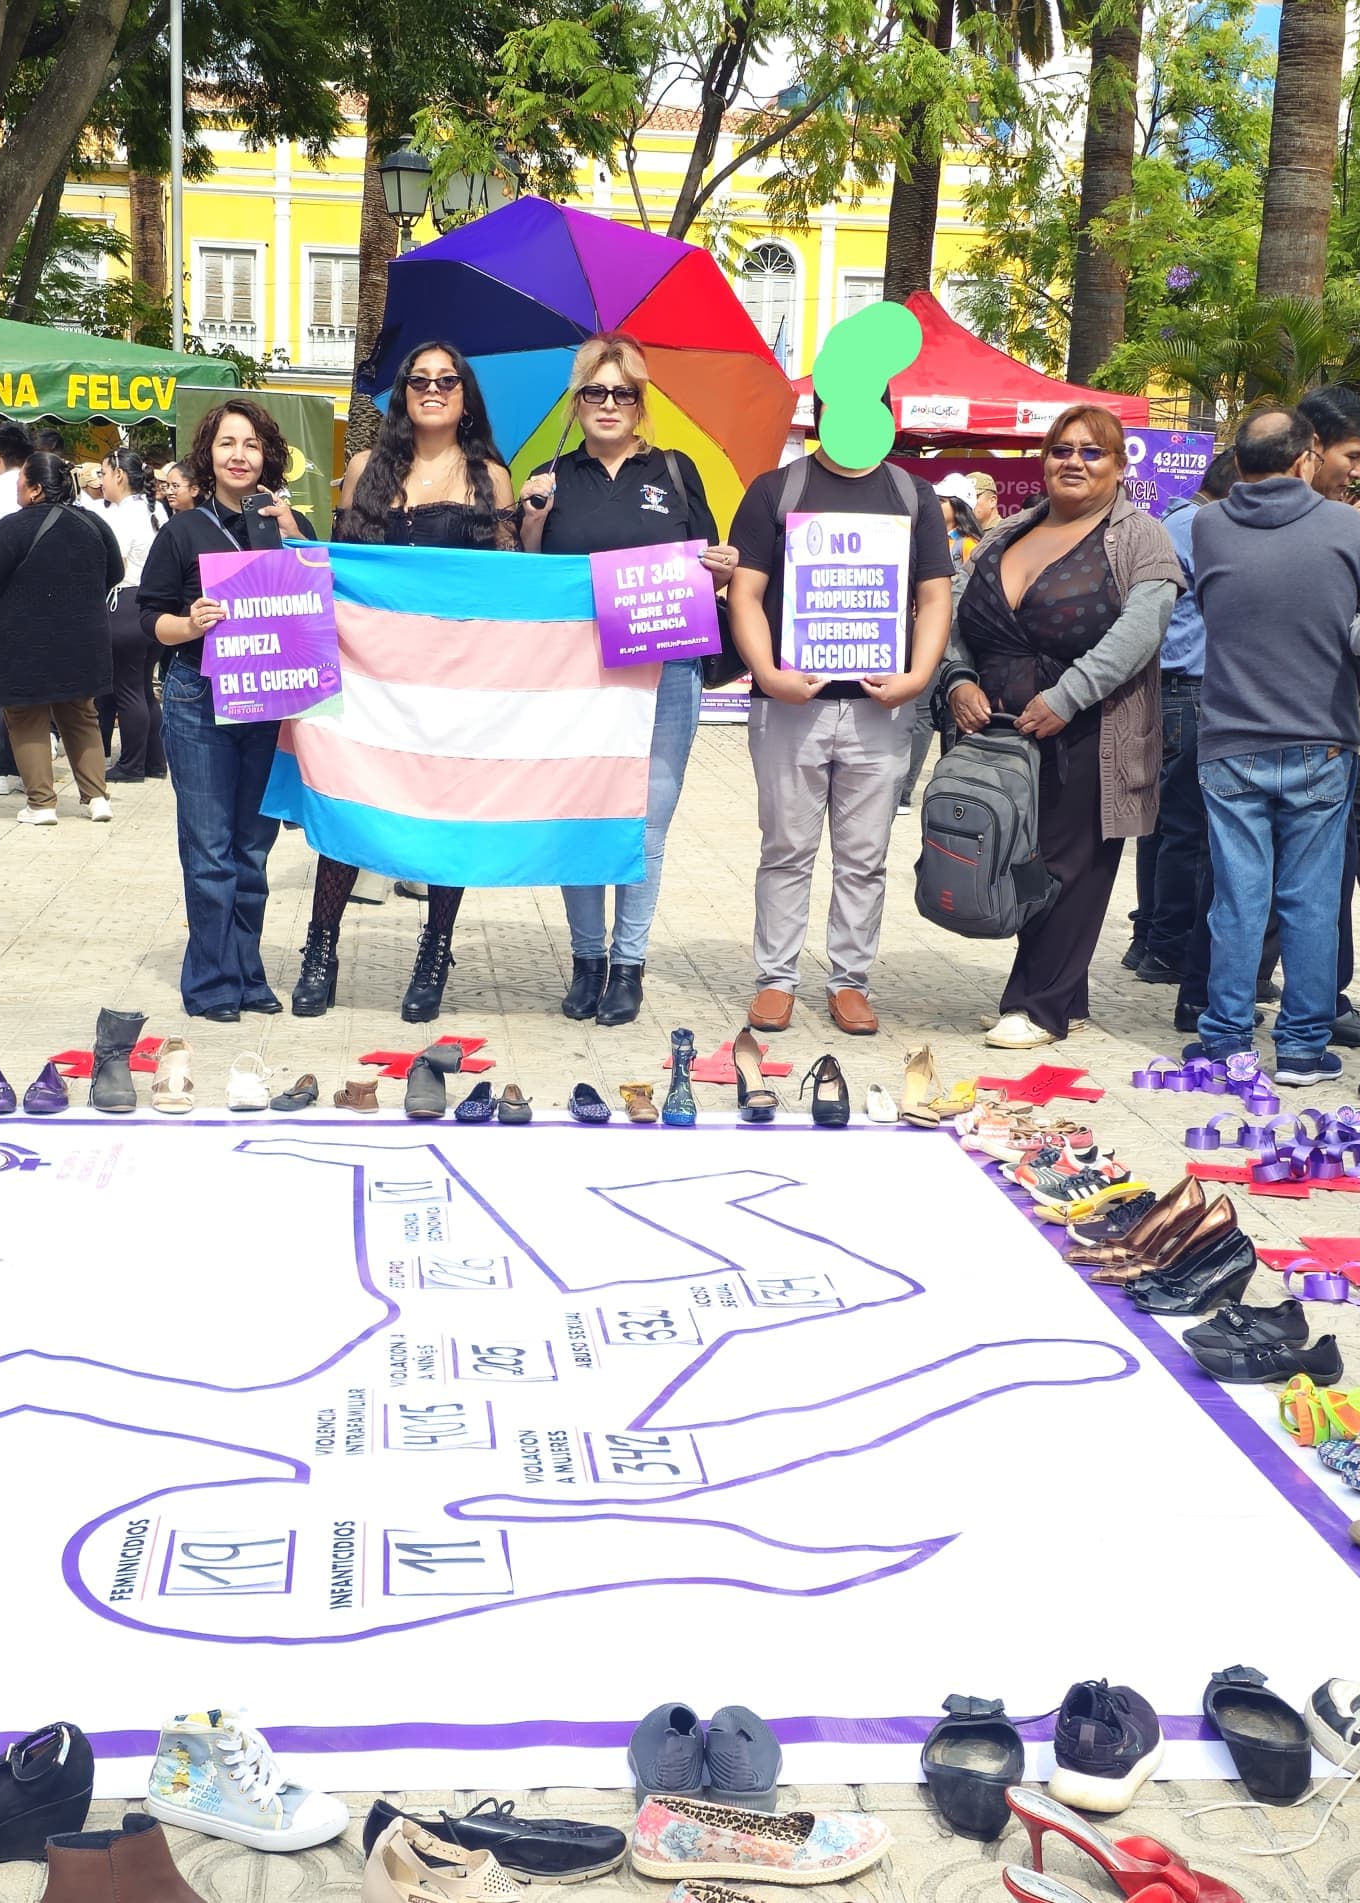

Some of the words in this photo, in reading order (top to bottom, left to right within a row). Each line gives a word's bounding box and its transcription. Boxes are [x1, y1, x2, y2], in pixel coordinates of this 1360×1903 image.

[67, 373, 177, 411] FELCV
[1124, 436, 1146, 464] O
[1153, 452, 1207, 468] 4321178
[1125, 480, 1158, 501] NCIA
[830, 532, 861, 554] NO
[616, 565, 646, 589] LEY
[811, 568, 884, 587] QUEREMOS
[234, 590, 323, 619] AUTONOMÍA
[614, 595, 636, 608] POR
[640, 592, 664, 604] UNA
[667, 587, 695, 599] VIDA
[806, 590, 890, 609] PROPUESTAS
[631, 606, 662, 620] LIBRE
[666, 603, 681, 614] DE
[629, 617, 687, 634] VIOLENCIA
[808, 622, 879, 641] QUEREMOS
[215, 633, 281, 658] EMPIEZA
[800, 643, 891, 669] ACCIONES
[219, 673, 239, 695] EN
[242, 672, 258, 693] EL
[260, 668, 319, 691] CUERPO
[389, 1260, 405, 1289] ESTUPRO
[756, 1276, 821, 1300] 34
[715, 1282, 739, 1309] SEXUAL
[565, 1311, 587, 1342] SEXUAL
[471, 1344, 526, 1376] 205
[570, 1342, 592, 1369] ABUSO
[418, 1371, 436, 1380] A
[315, 1408, 337, 1457] VIOLENCIA
[345, 1388, 366, 1456] INTRAFAMILIAR
[399, 1402, 468, 1445] 4015
[547, 1430, 574, 1474] MUJERES
[605, 1434, 681, 1476] 342
[556, 1476, 577, 1484] A
[109, 1518, 151, 1603] FEMINICIDIOS
[179, 1538, 286, 1586] 19
[329, 1519, 356, 1611] INFANTICIDIOS
[395, 1540, 486, 1574] 11
